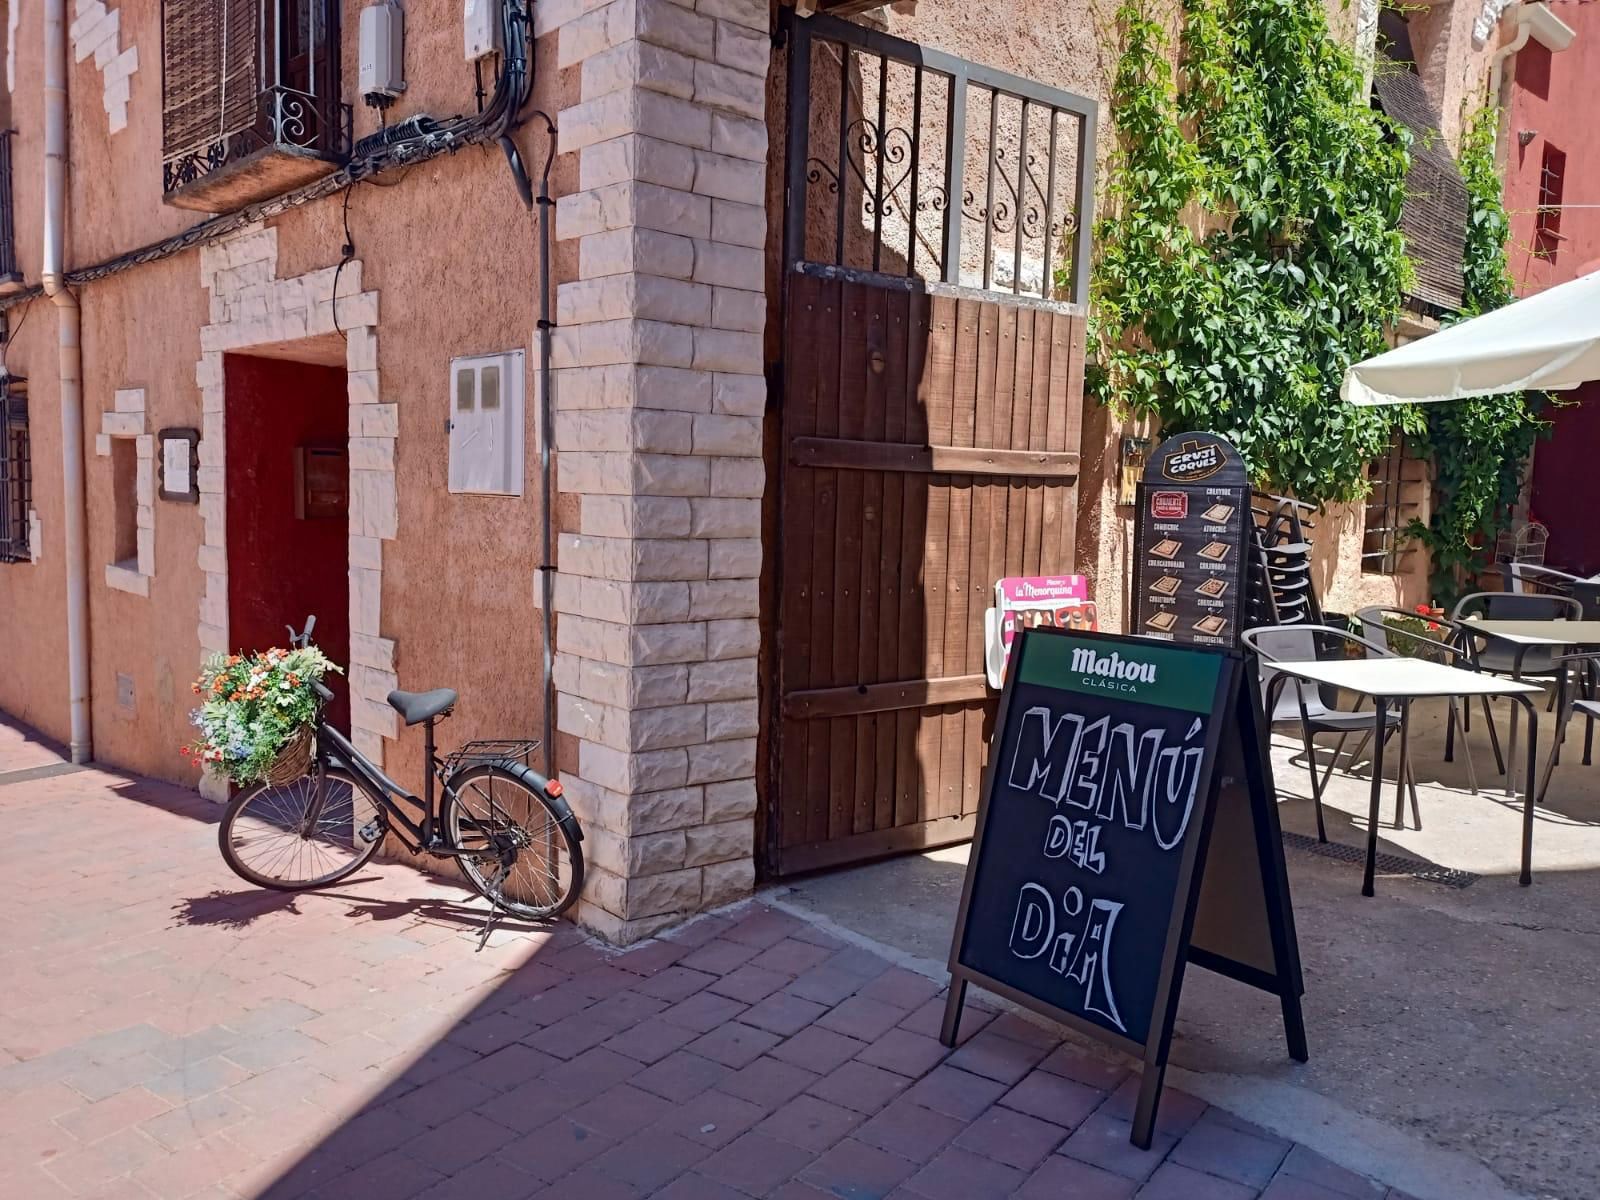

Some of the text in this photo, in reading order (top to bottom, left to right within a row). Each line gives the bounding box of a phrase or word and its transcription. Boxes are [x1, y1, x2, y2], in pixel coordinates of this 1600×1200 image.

[1171, 457, 1217, 473] COQUES
[1023, 582, 1073, 598] Menorquina
[1071, 647, 1156, 683] Mahou
[1082, 678, 1137, 693] CLÁSICA
[1008, 706, 1204, 850] MENÚ
[1043, 814, 1106, 875] DEL
